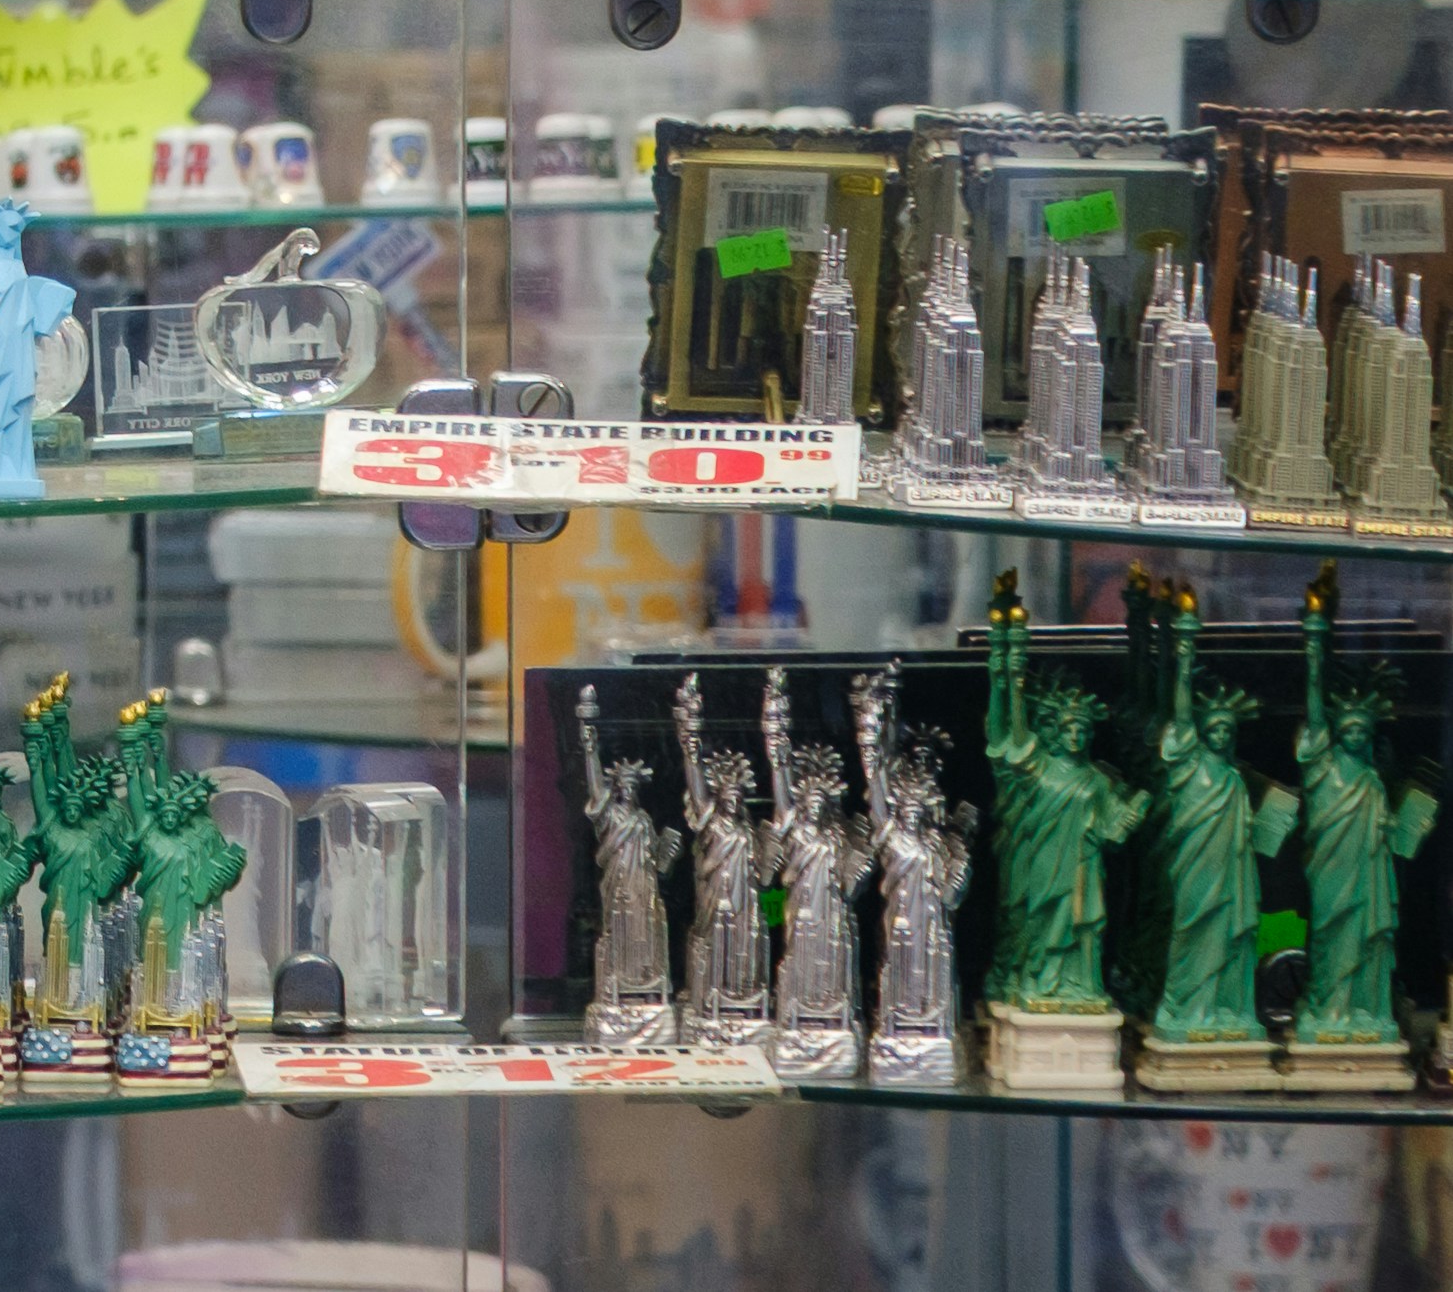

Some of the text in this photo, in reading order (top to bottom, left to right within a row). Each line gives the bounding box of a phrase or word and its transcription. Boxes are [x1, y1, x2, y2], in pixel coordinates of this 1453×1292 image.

[348, 417, 835, 444] EMPIRE STATE BUILDING
